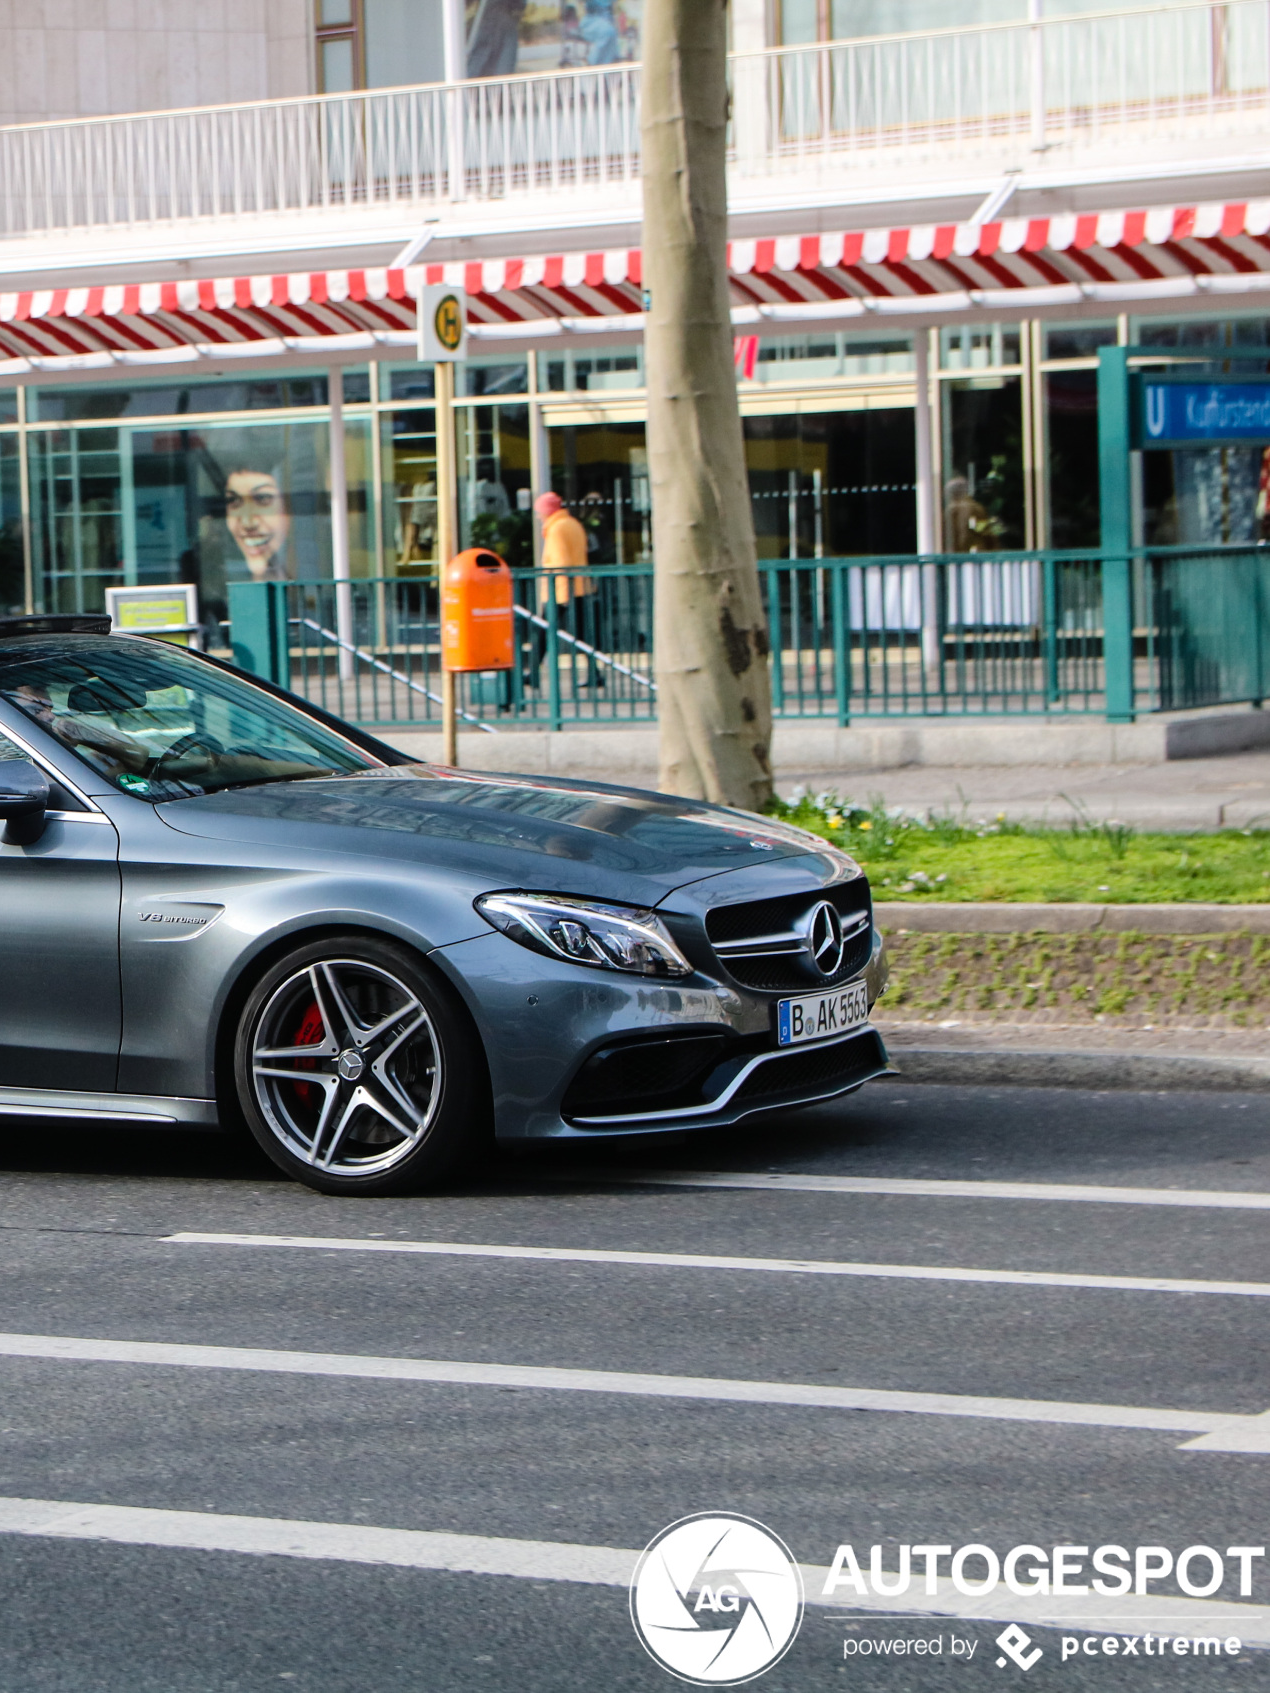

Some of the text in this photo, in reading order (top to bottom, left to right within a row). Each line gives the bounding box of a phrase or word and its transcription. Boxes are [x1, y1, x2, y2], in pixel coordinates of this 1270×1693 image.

[1147, 385, 1165, 437] U
[137, 911, 208, 925] V8 BITURBO
[792, 987, 867, 1037] B AK 5563
